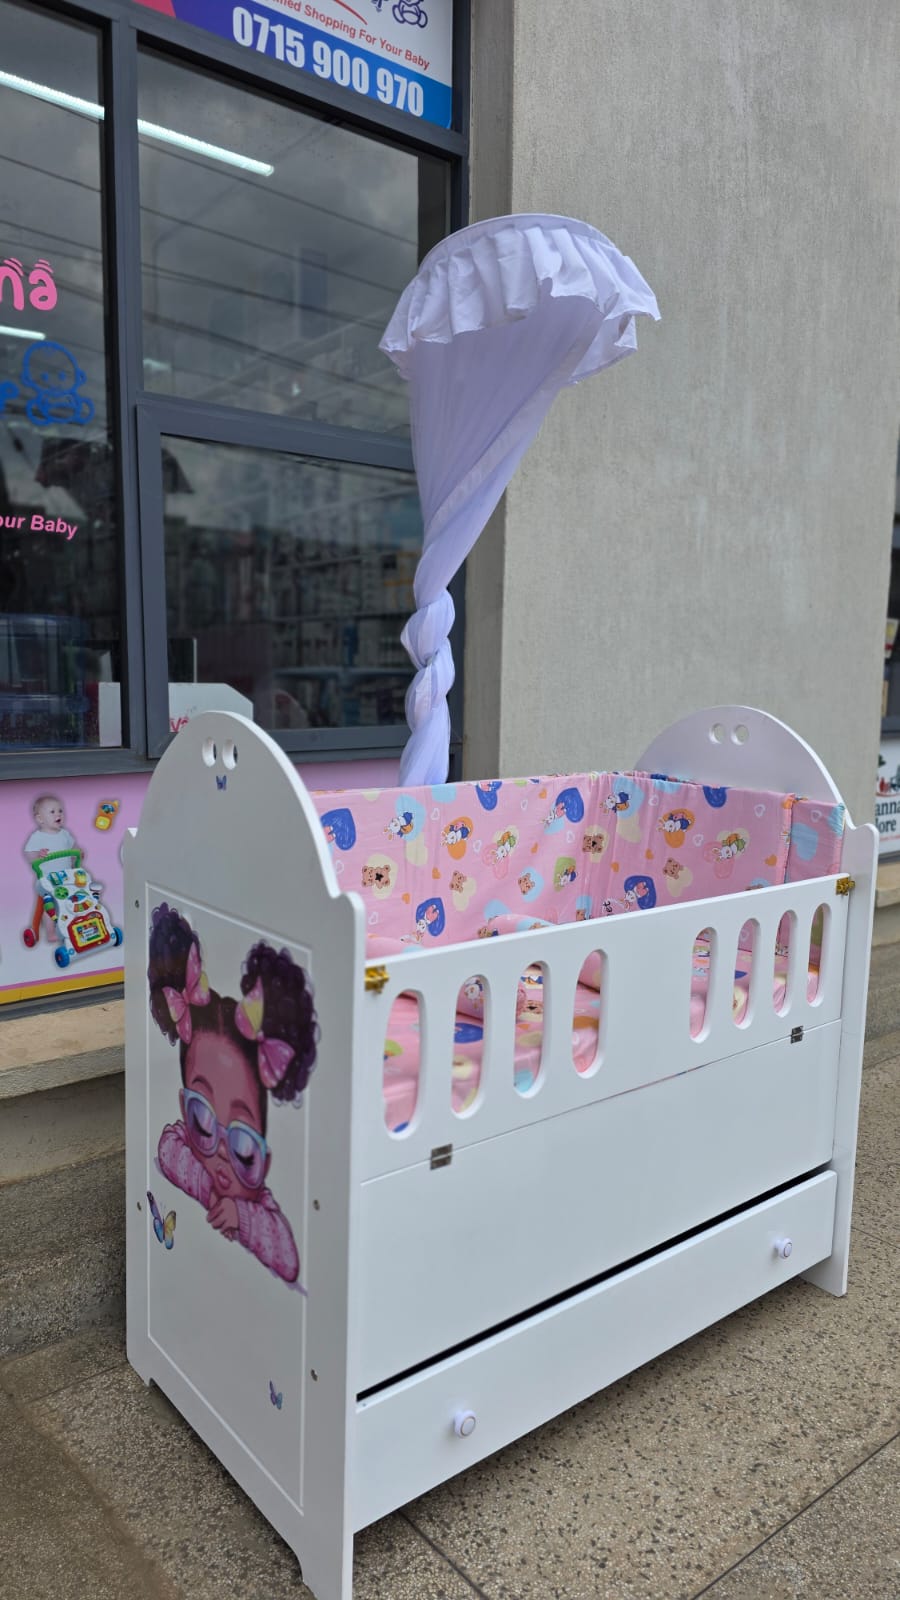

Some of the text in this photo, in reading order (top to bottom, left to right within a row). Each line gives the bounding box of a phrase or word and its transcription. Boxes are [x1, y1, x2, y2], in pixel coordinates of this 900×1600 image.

[233, 6, 424, 117] 0715 900 970
[303, 4, 357, 37] Shopping
[358, 30, 377, 45] For
[379, 38, 404, 57] Your
[405, 50, 430, 71] Baby
[30, 514, 78, 540] Baby
